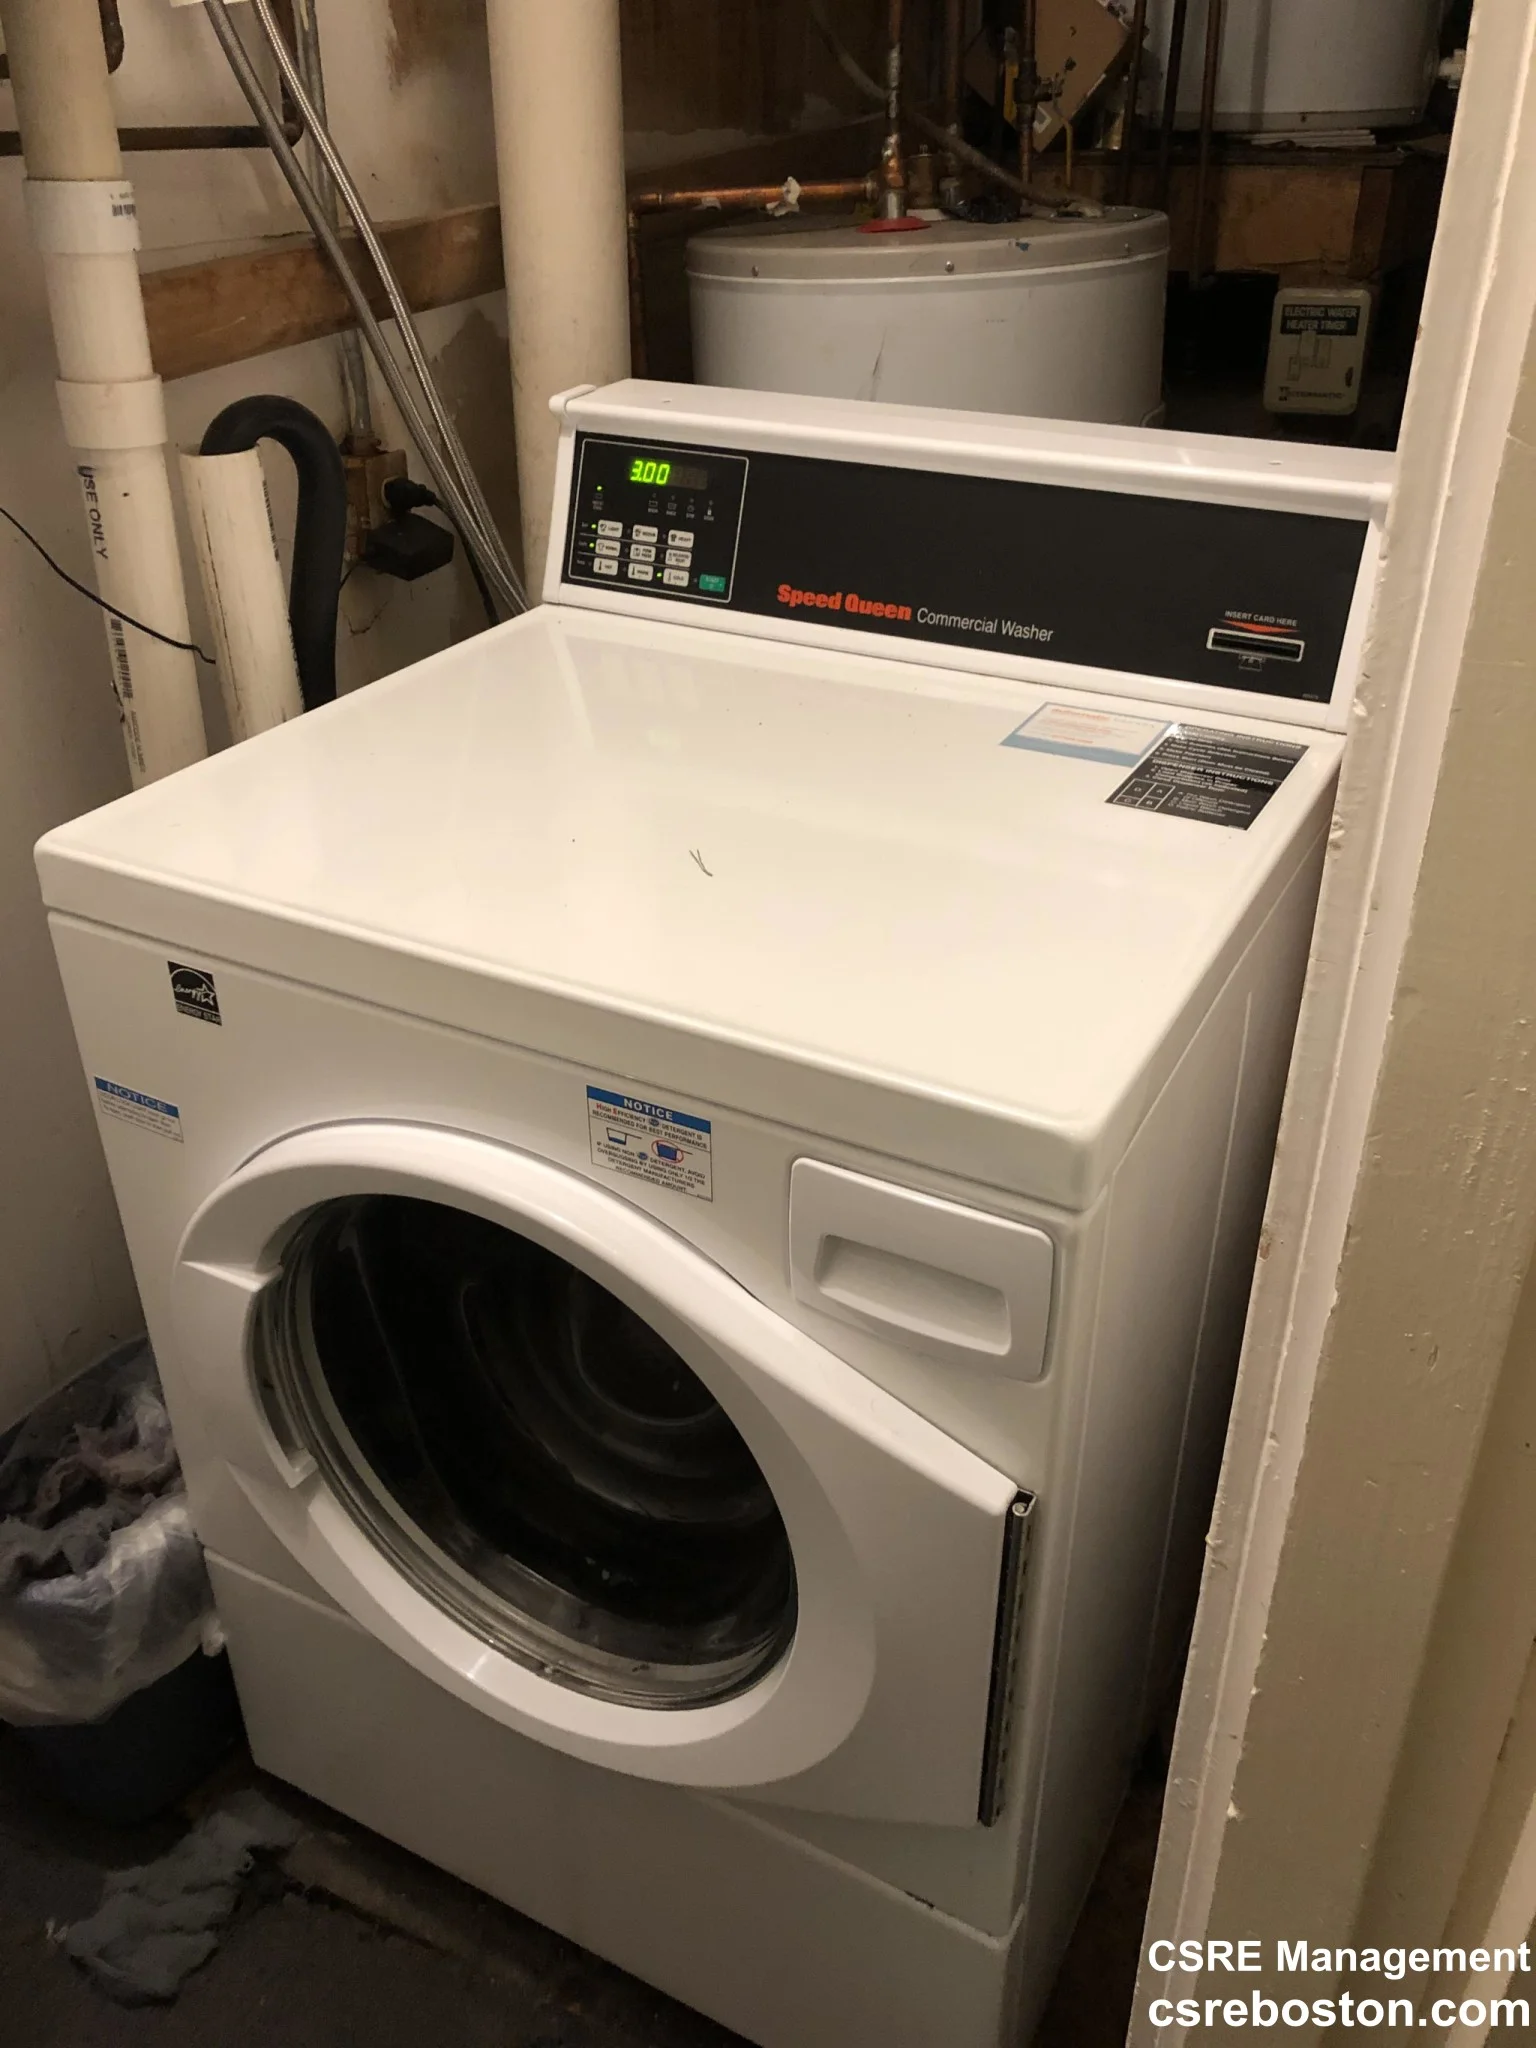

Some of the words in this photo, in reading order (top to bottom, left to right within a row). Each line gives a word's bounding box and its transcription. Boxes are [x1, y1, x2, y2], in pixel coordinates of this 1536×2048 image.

[78, 465, 98, 504] USE
[89, 507, 109, 560] ONLY
[777, 583, 841, 609] Speed
[844, 593, 912, 621] Queen
[917, 607, 998, 634] Commercial
[1001, 620, 1054, 642] Washer
[1225, 610, 1252, 621] INSERT
[1253, 614, 1275, 624] CARD
[1276, 617, 1297, 627] HERE
[107, 1082, 168, 1112] NOTICE
[623, 1098, 673, 1120] NOTICE
[593, 1110, 635, 1127] RECOMMENDED
[636, 1123, 647, 1131] FOR
[649, 1127, 663, 1136] BEST
[665, 1132, 707, 1149] PERFORMANCE
[612, 1108, 646, 1124] EFFICIENCY
[662, 1124, 696, 1138] DETERGENT
[608, 1157, 642, 1172] DETERGENT
[668, 1170, 684, 1179] ONLY
